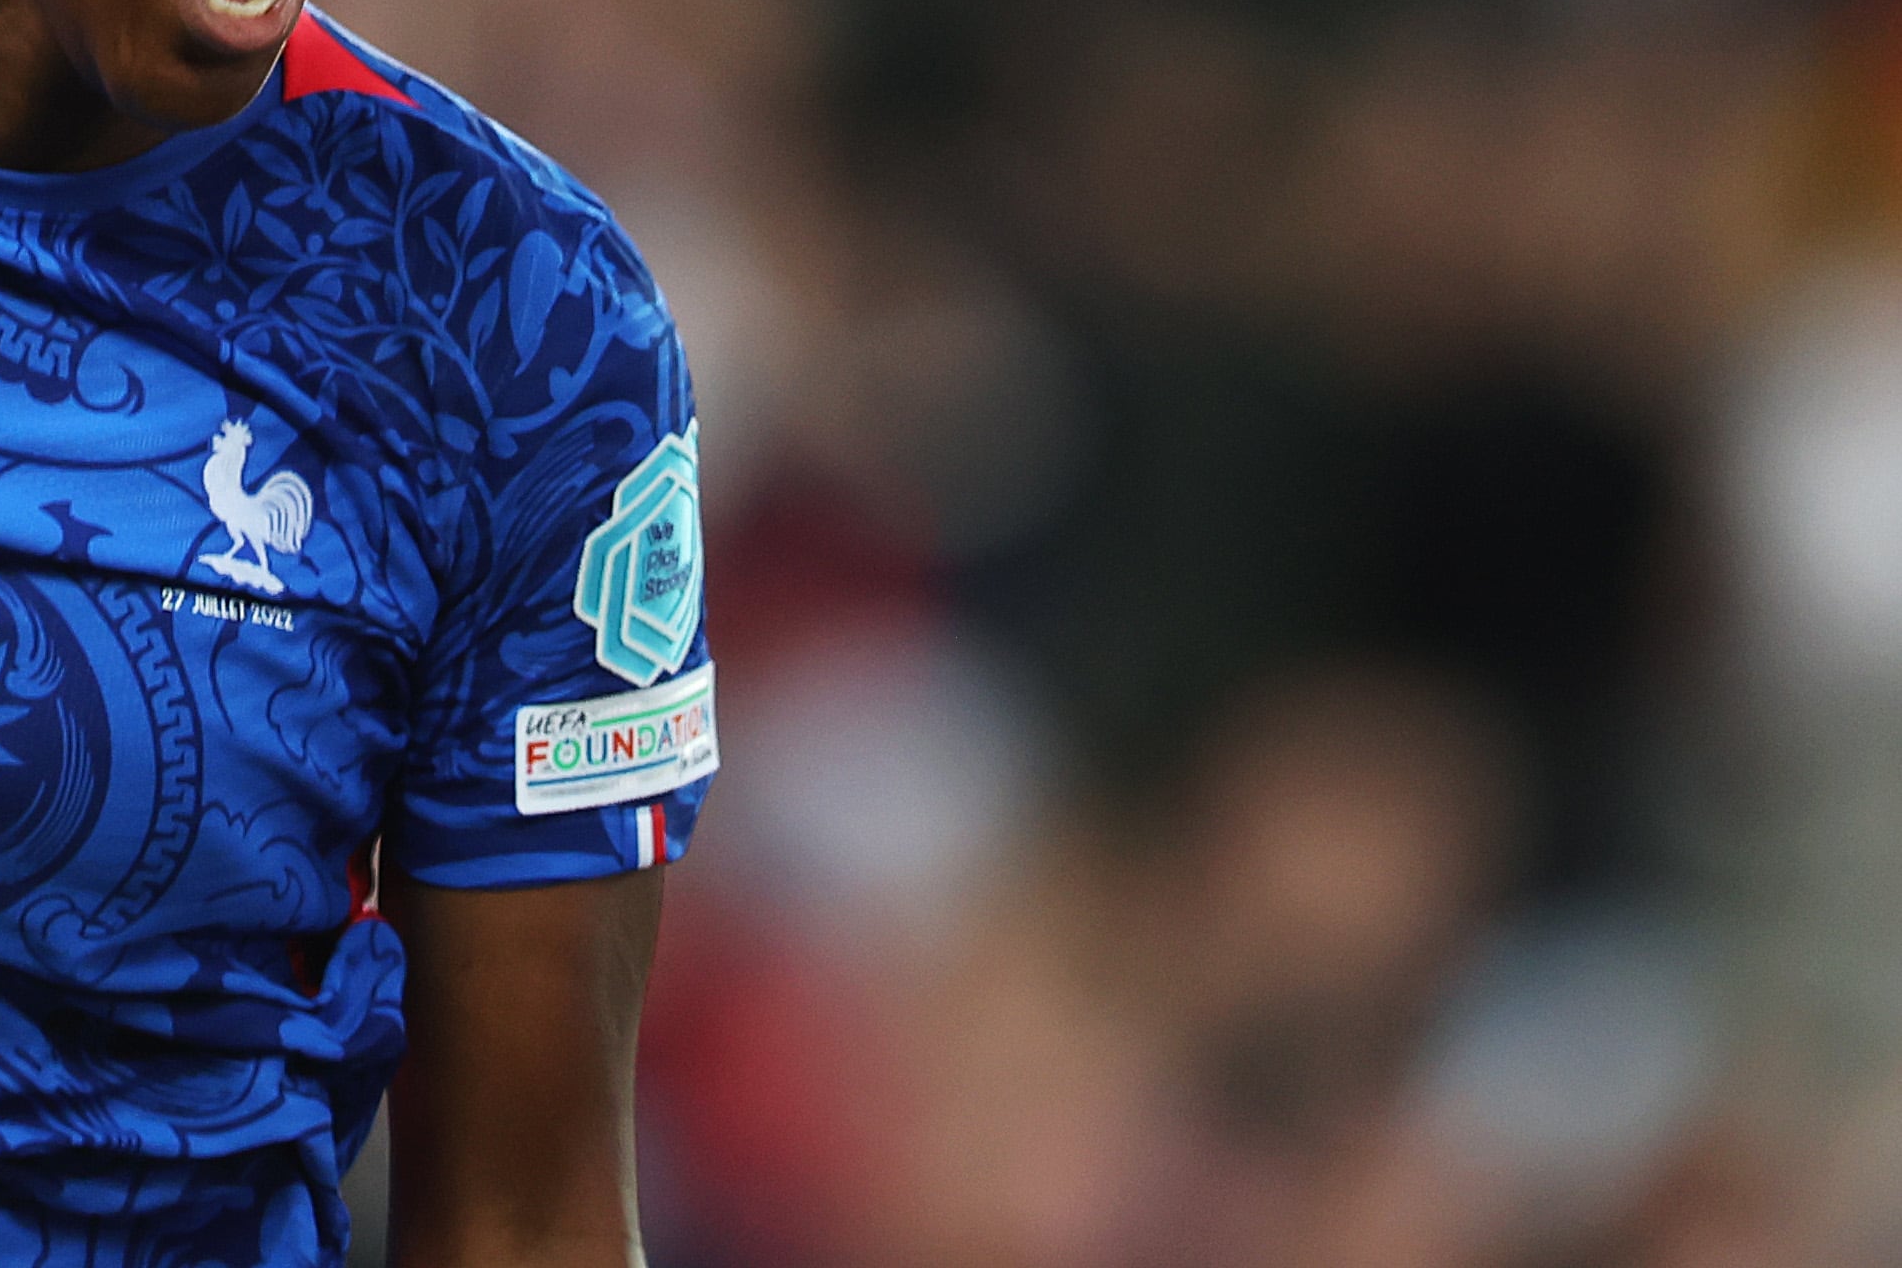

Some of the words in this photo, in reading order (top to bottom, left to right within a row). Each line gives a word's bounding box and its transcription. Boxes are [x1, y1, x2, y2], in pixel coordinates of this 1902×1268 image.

[644, 544, 680, 577] Play
[162, 587, 185, 611] 27
[251, 604, 294, 631] 2022
[525, 709, 586, 735] UEFA
